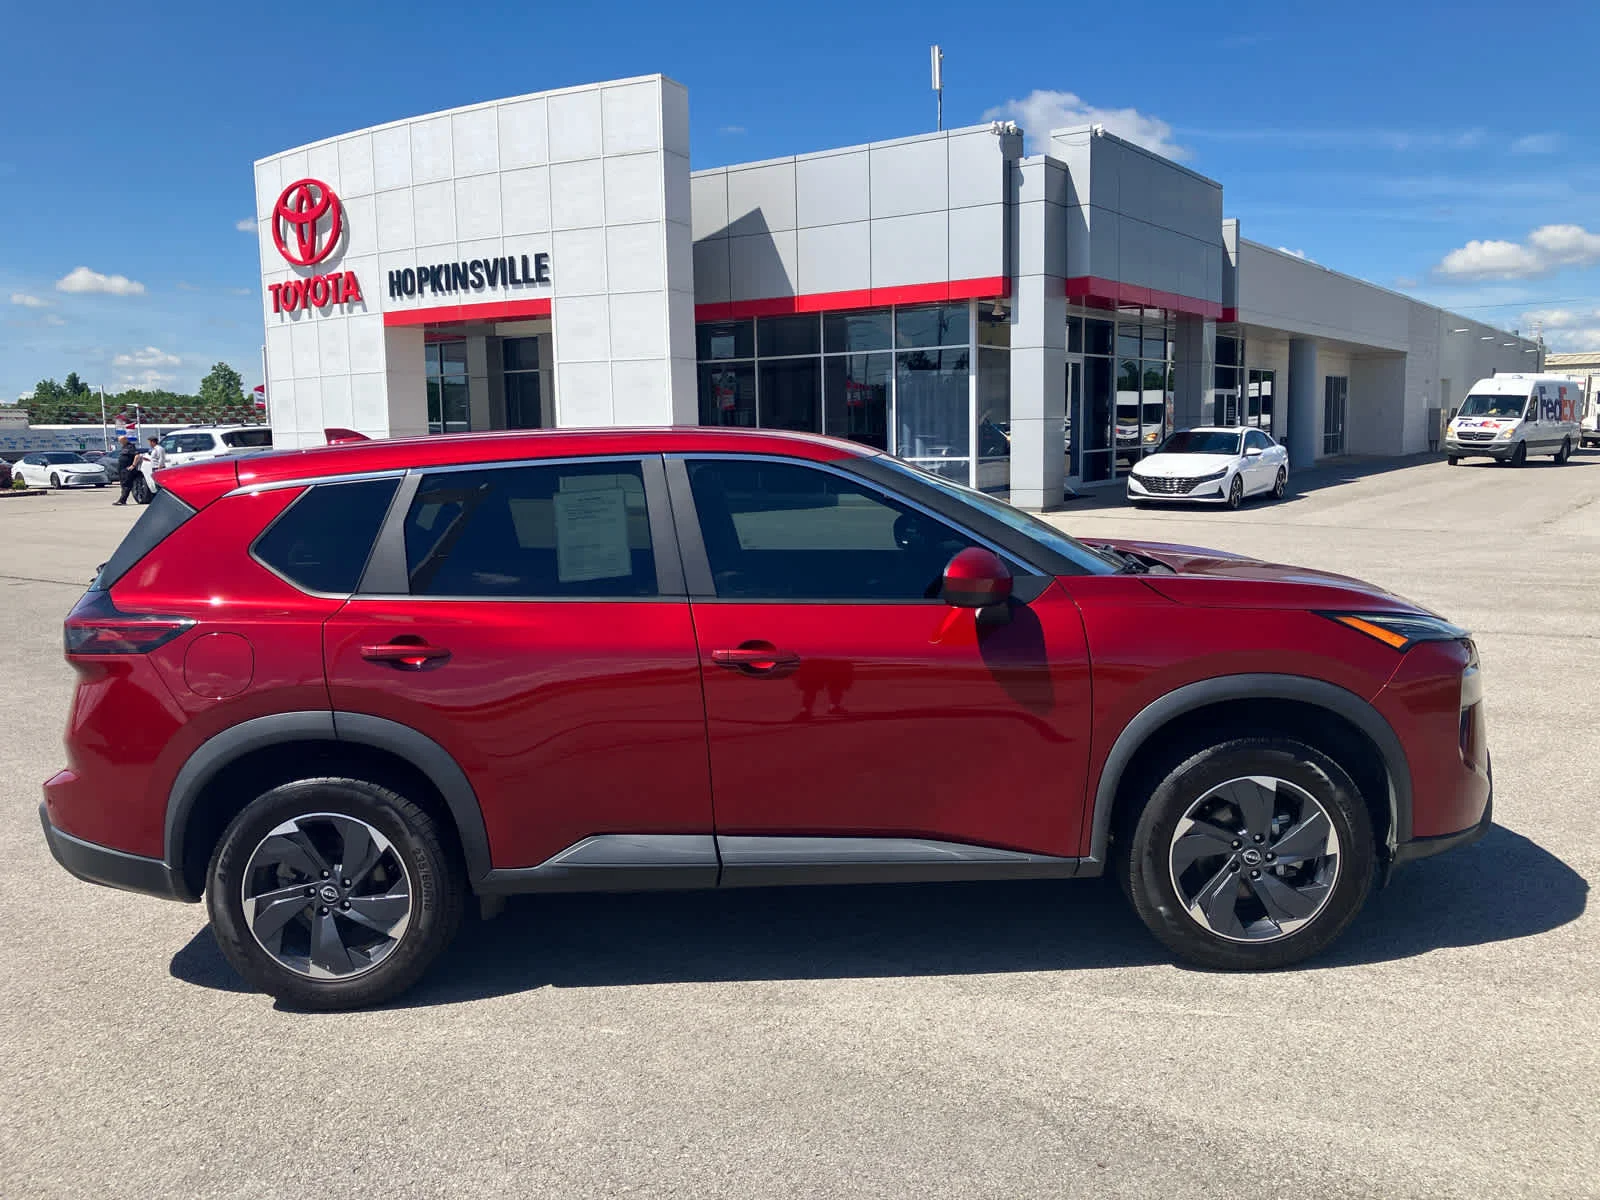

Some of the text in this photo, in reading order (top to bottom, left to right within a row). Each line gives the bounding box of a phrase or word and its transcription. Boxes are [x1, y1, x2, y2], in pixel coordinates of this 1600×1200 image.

[268, 271, 364, 313] TOYOTA
[388, 252, 551, 297] HOPKINSVILLE
[1538, 385, 1577, 422] FedEx
[1457, 420, 1502, 429] FedEx
